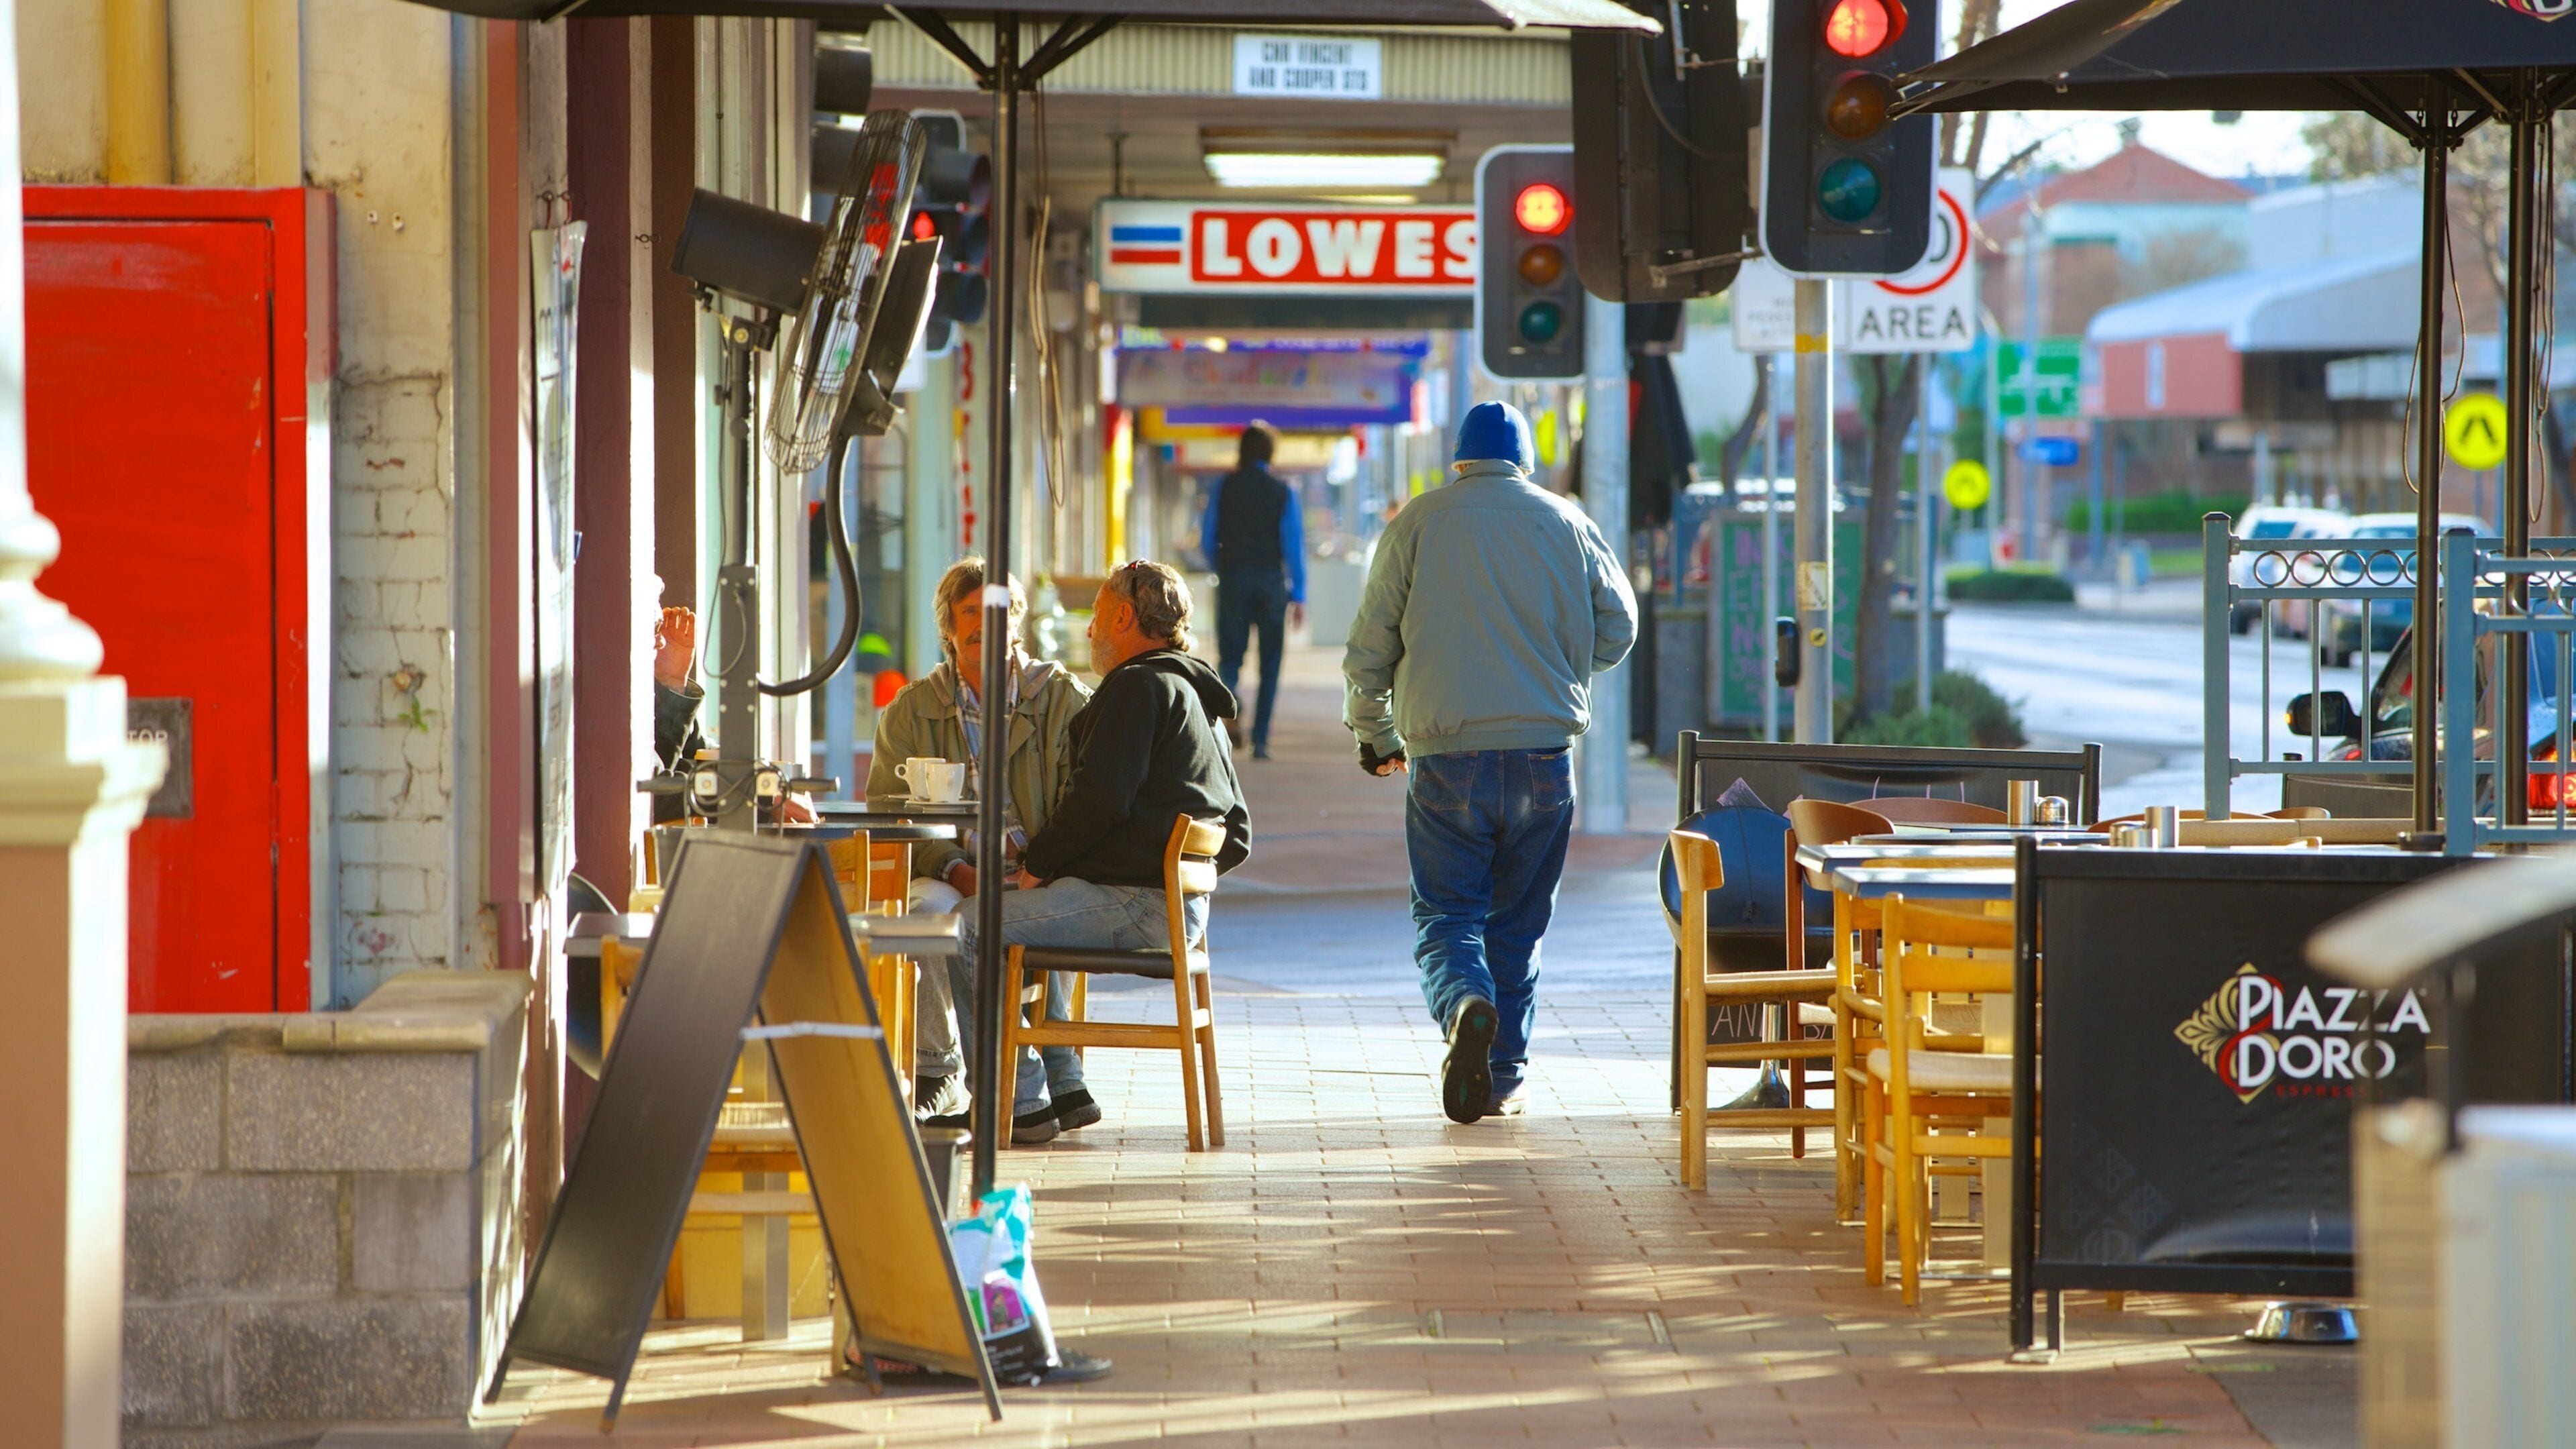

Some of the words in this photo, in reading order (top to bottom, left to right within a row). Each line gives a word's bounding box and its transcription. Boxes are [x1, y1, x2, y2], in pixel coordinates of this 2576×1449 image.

[1299, 42, 1353, 64] VINCENT
[1249, 66, 1276, 88] AND
[1285, 68, 1336, 89] COOPER
[1343, 70, 1368, 91] STS
[1202, 217, 1475, 278] LOWES
[1858, 305, 1967, 339] AREA
[2239, 975, 2432, 1034] PIAZZA
[2275, 1083, 2383, 1098] ESPRESS
